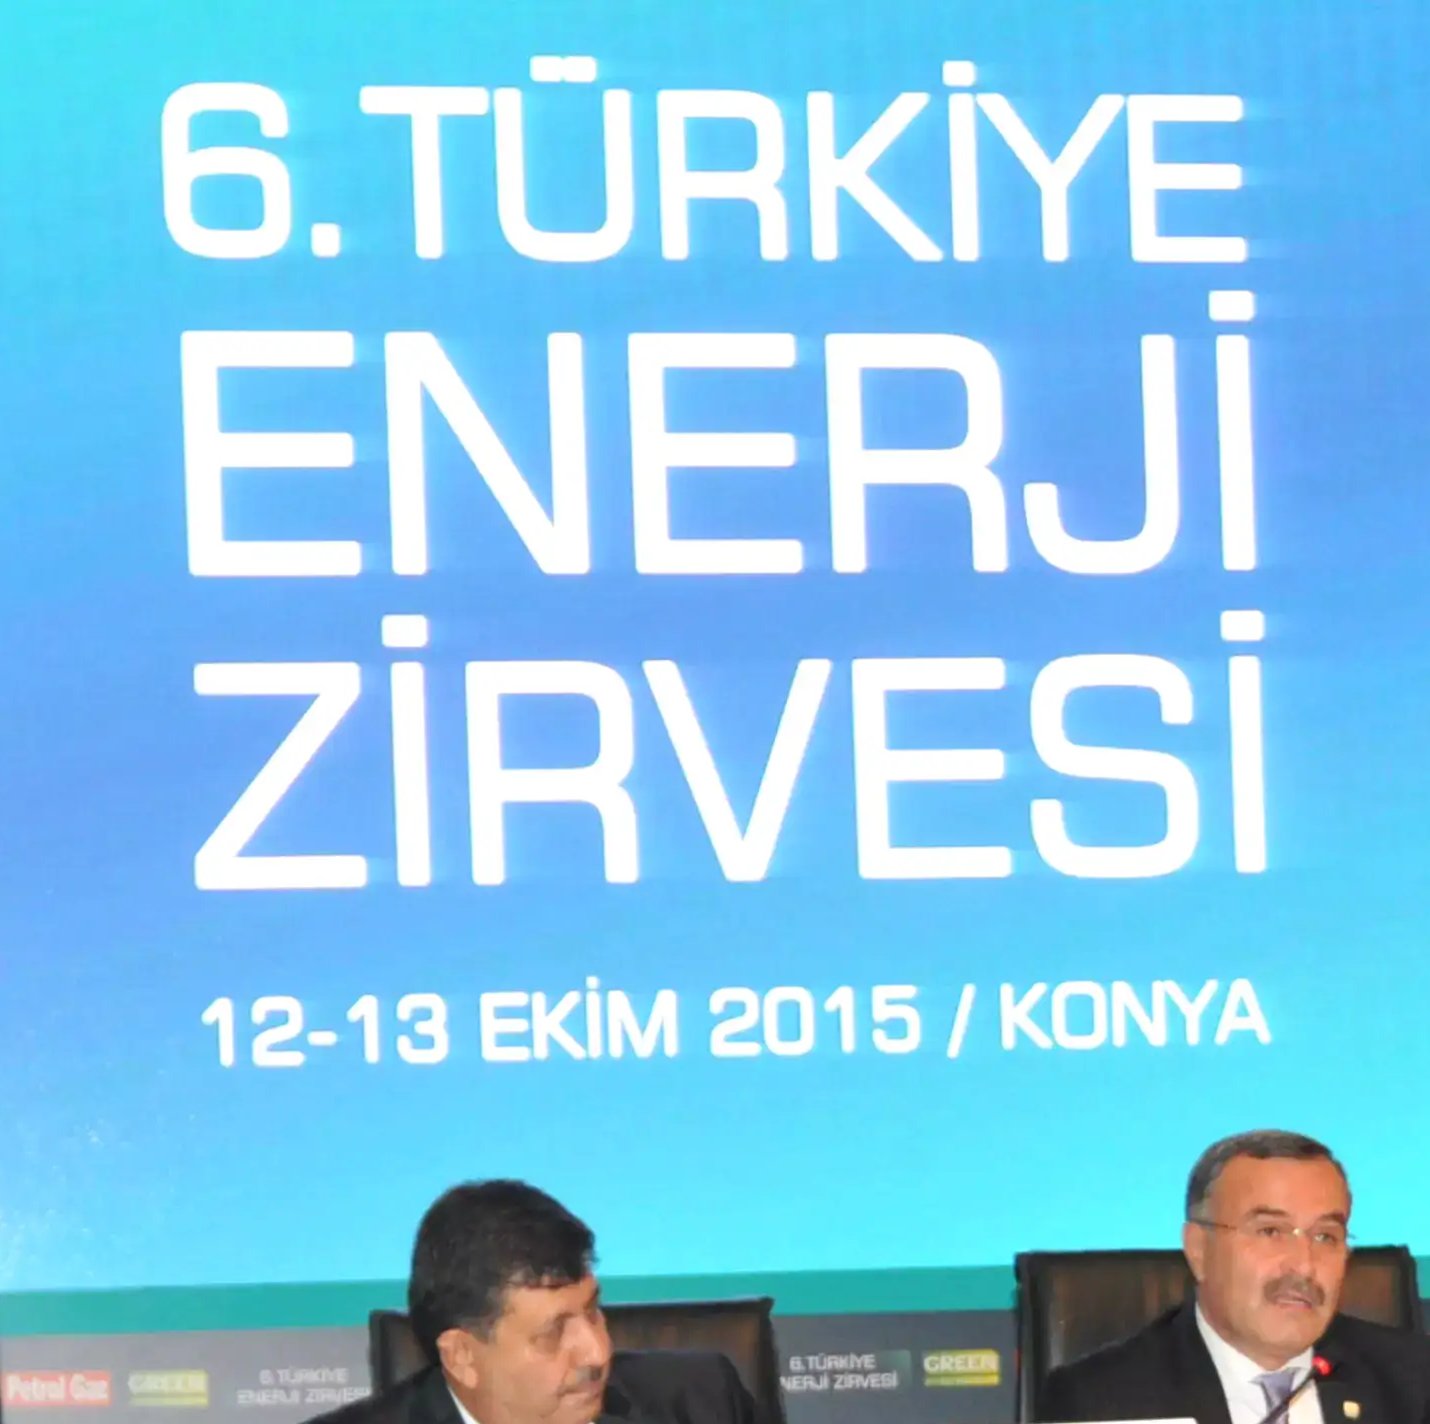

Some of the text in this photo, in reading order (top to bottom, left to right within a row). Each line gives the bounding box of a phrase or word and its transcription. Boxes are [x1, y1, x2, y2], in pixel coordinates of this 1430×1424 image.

[181, 289, 1256, 577] ENERJİ
[193, 609, 1267, 890] ZİRVESİ
[201, 977, 1273, 1066] 12-13 EKİM 2015 / KONYA
[7, 1373, 108, 1400] Petrol Gaz
[779, 1370, 898, 1391] NERJİ ZİRVESİ
[924, 1355, 998, 1372] GREEN
